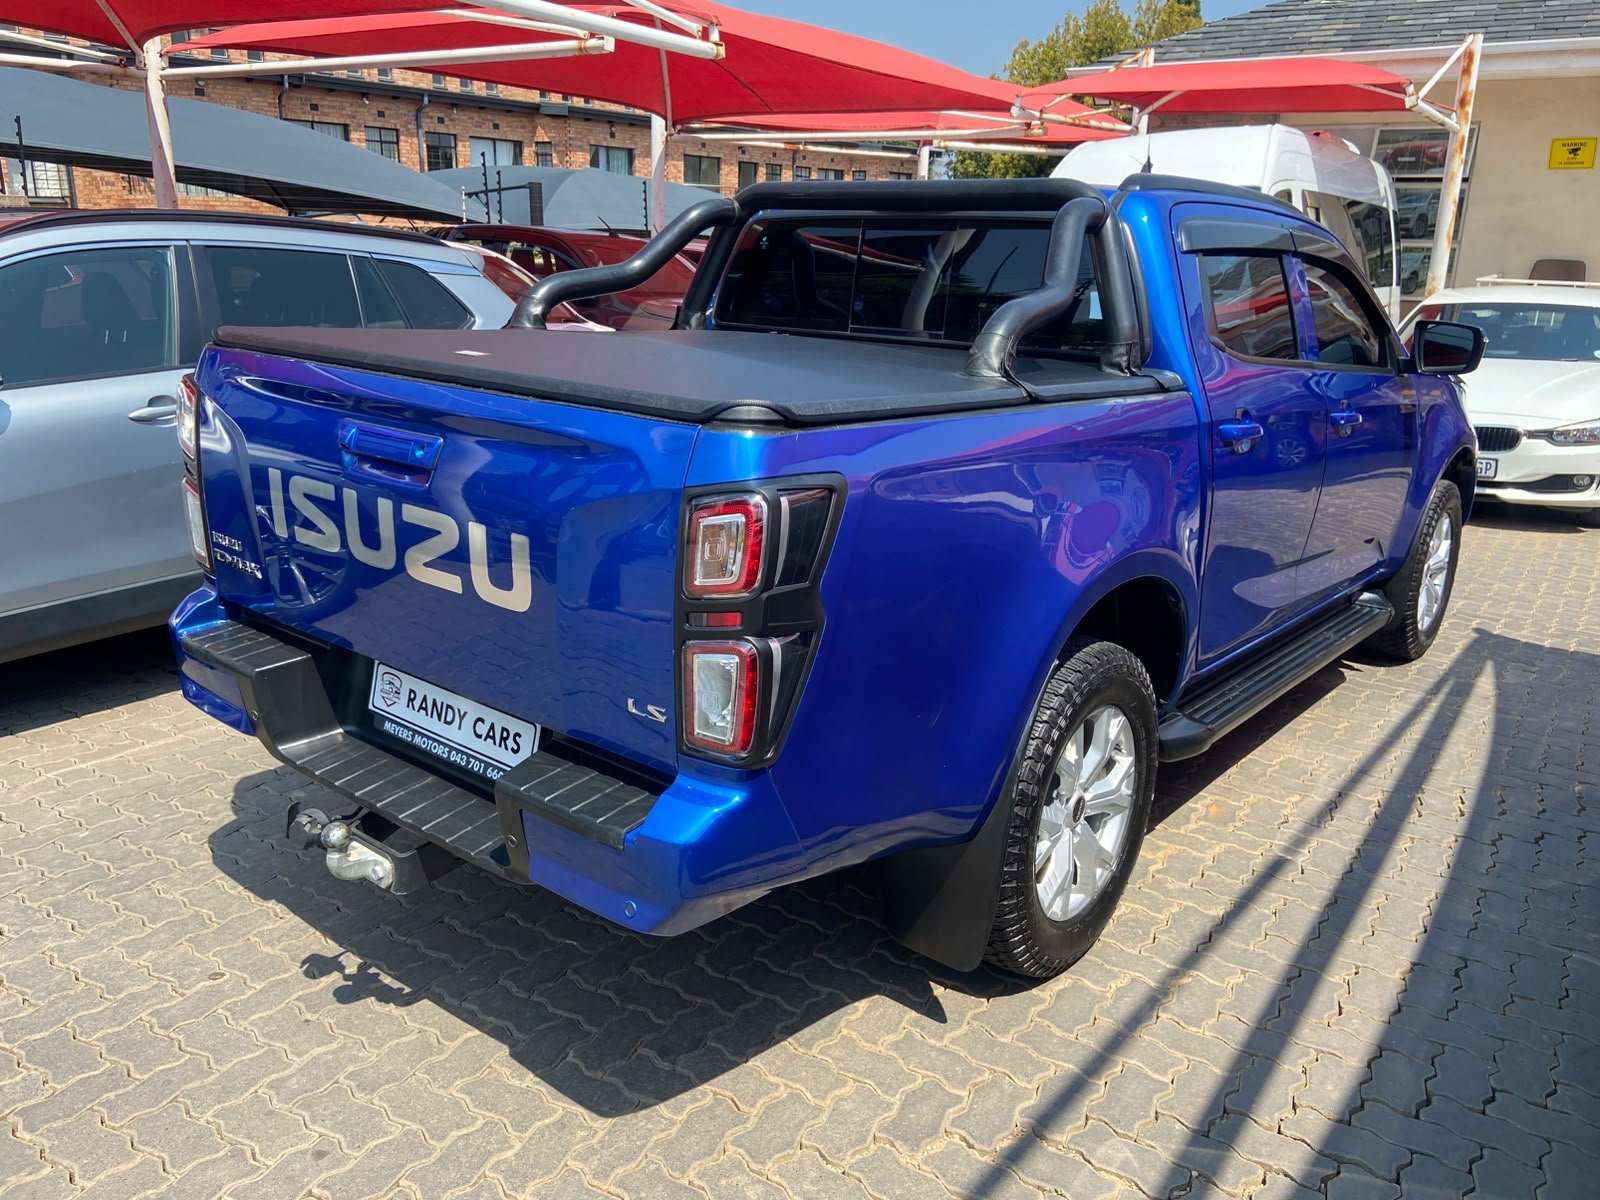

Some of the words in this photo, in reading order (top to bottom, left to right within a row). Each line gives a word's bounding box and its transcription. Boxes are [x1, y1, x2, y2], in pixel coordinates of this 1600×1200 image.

[267, 467, 532, 613] ISUZU
[406, 688, 468, 731] RANDY
[472, 716, 522, 755] CARS
[627, 698, 667, 723] LS
[384, 721, 413, 742] MEYERS
[413, 735, 449, 758] MOTORS
[450, 750, 467, 766] 043
[468, 757, 485, 774] 701
